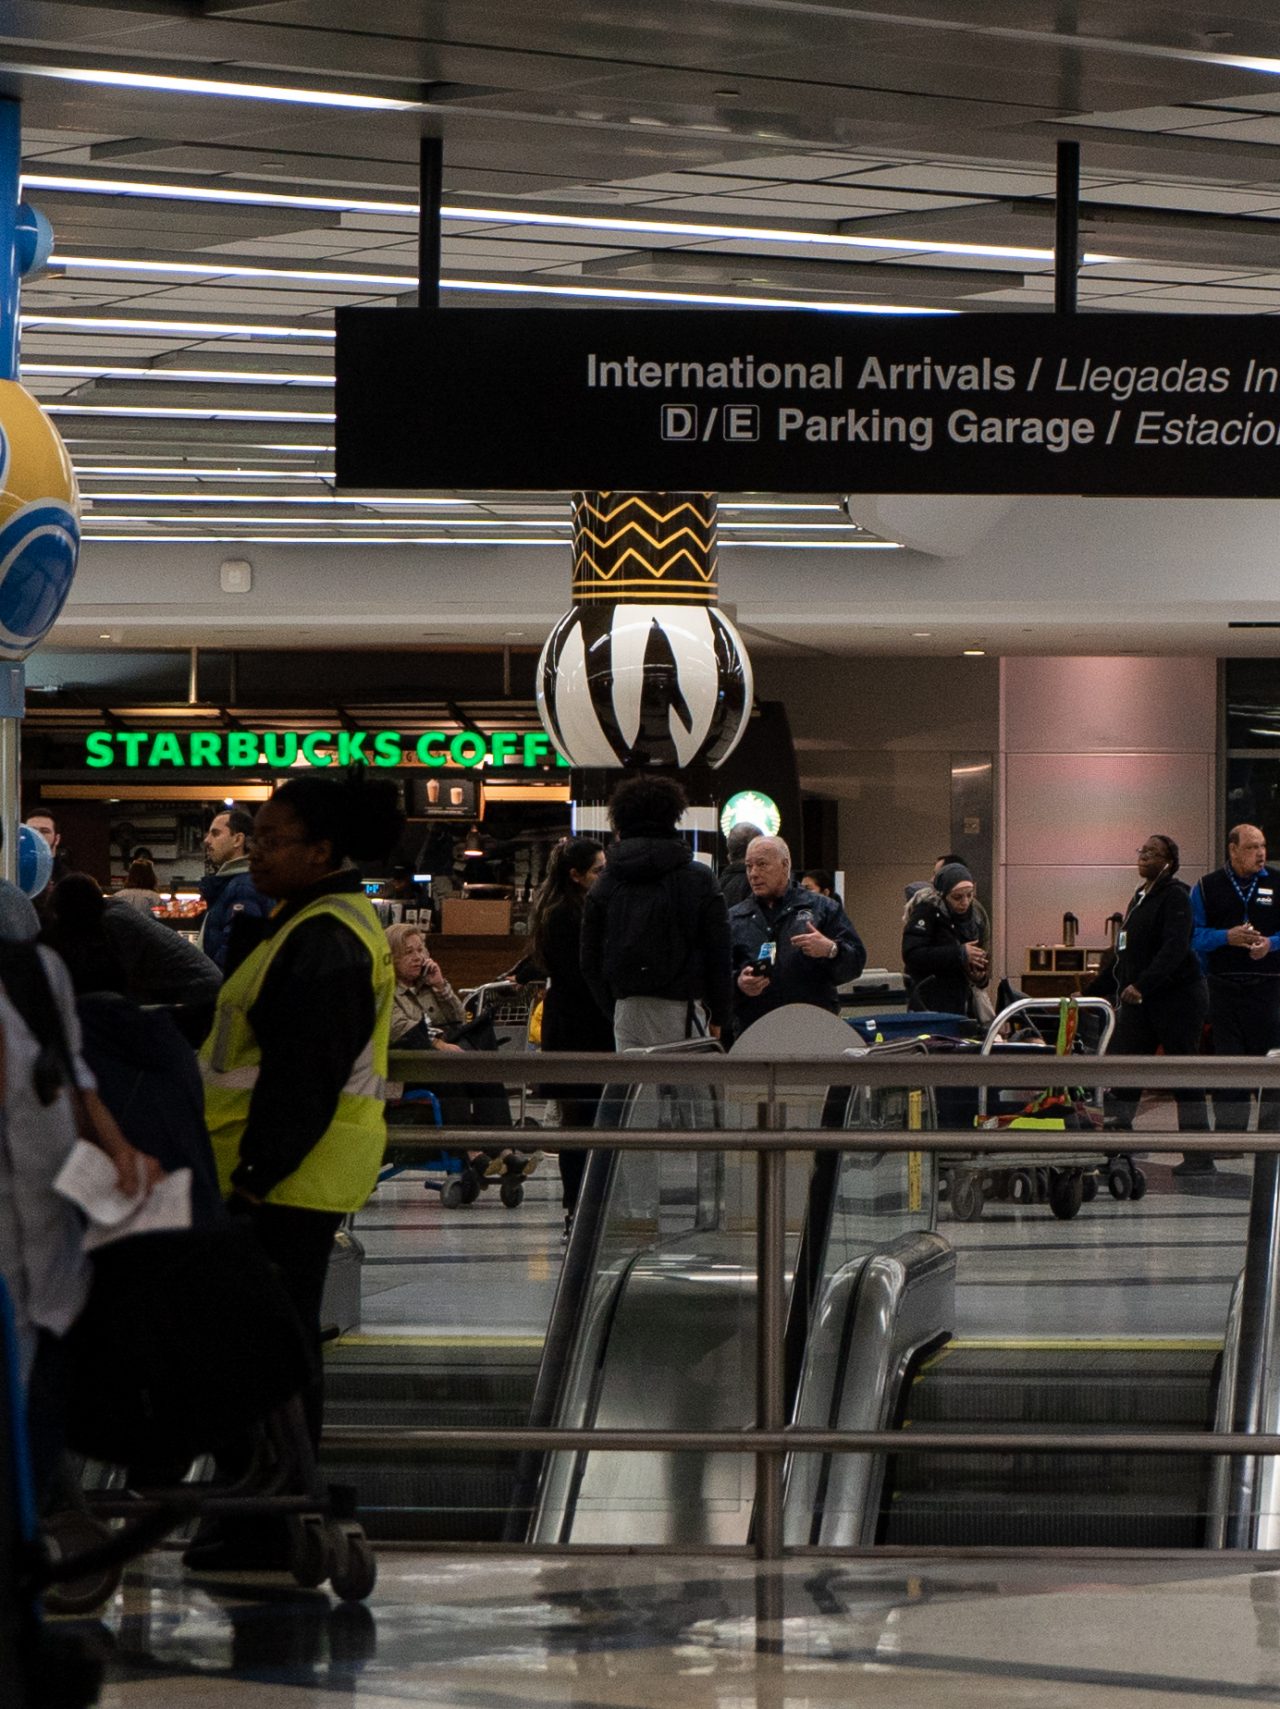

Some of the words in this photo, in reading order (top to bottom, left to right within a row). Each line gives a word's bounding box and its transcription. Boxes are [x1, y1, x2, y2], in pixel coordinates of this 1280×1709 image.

[588, 353, 843, 390] International
[857, 356, 1016, 391] Arrivals
[1026, 357, 1043, 392] /
[1055, 357, 1231, 400] Llegadas
[778, 407, 933, 452] Parking
[947, 408, 1095, 453] Garage
[1105, 409, 1121, 445] /
[85, 730, 402, 768] STARBUCKS
[416, 731, 570, 768] COFF
